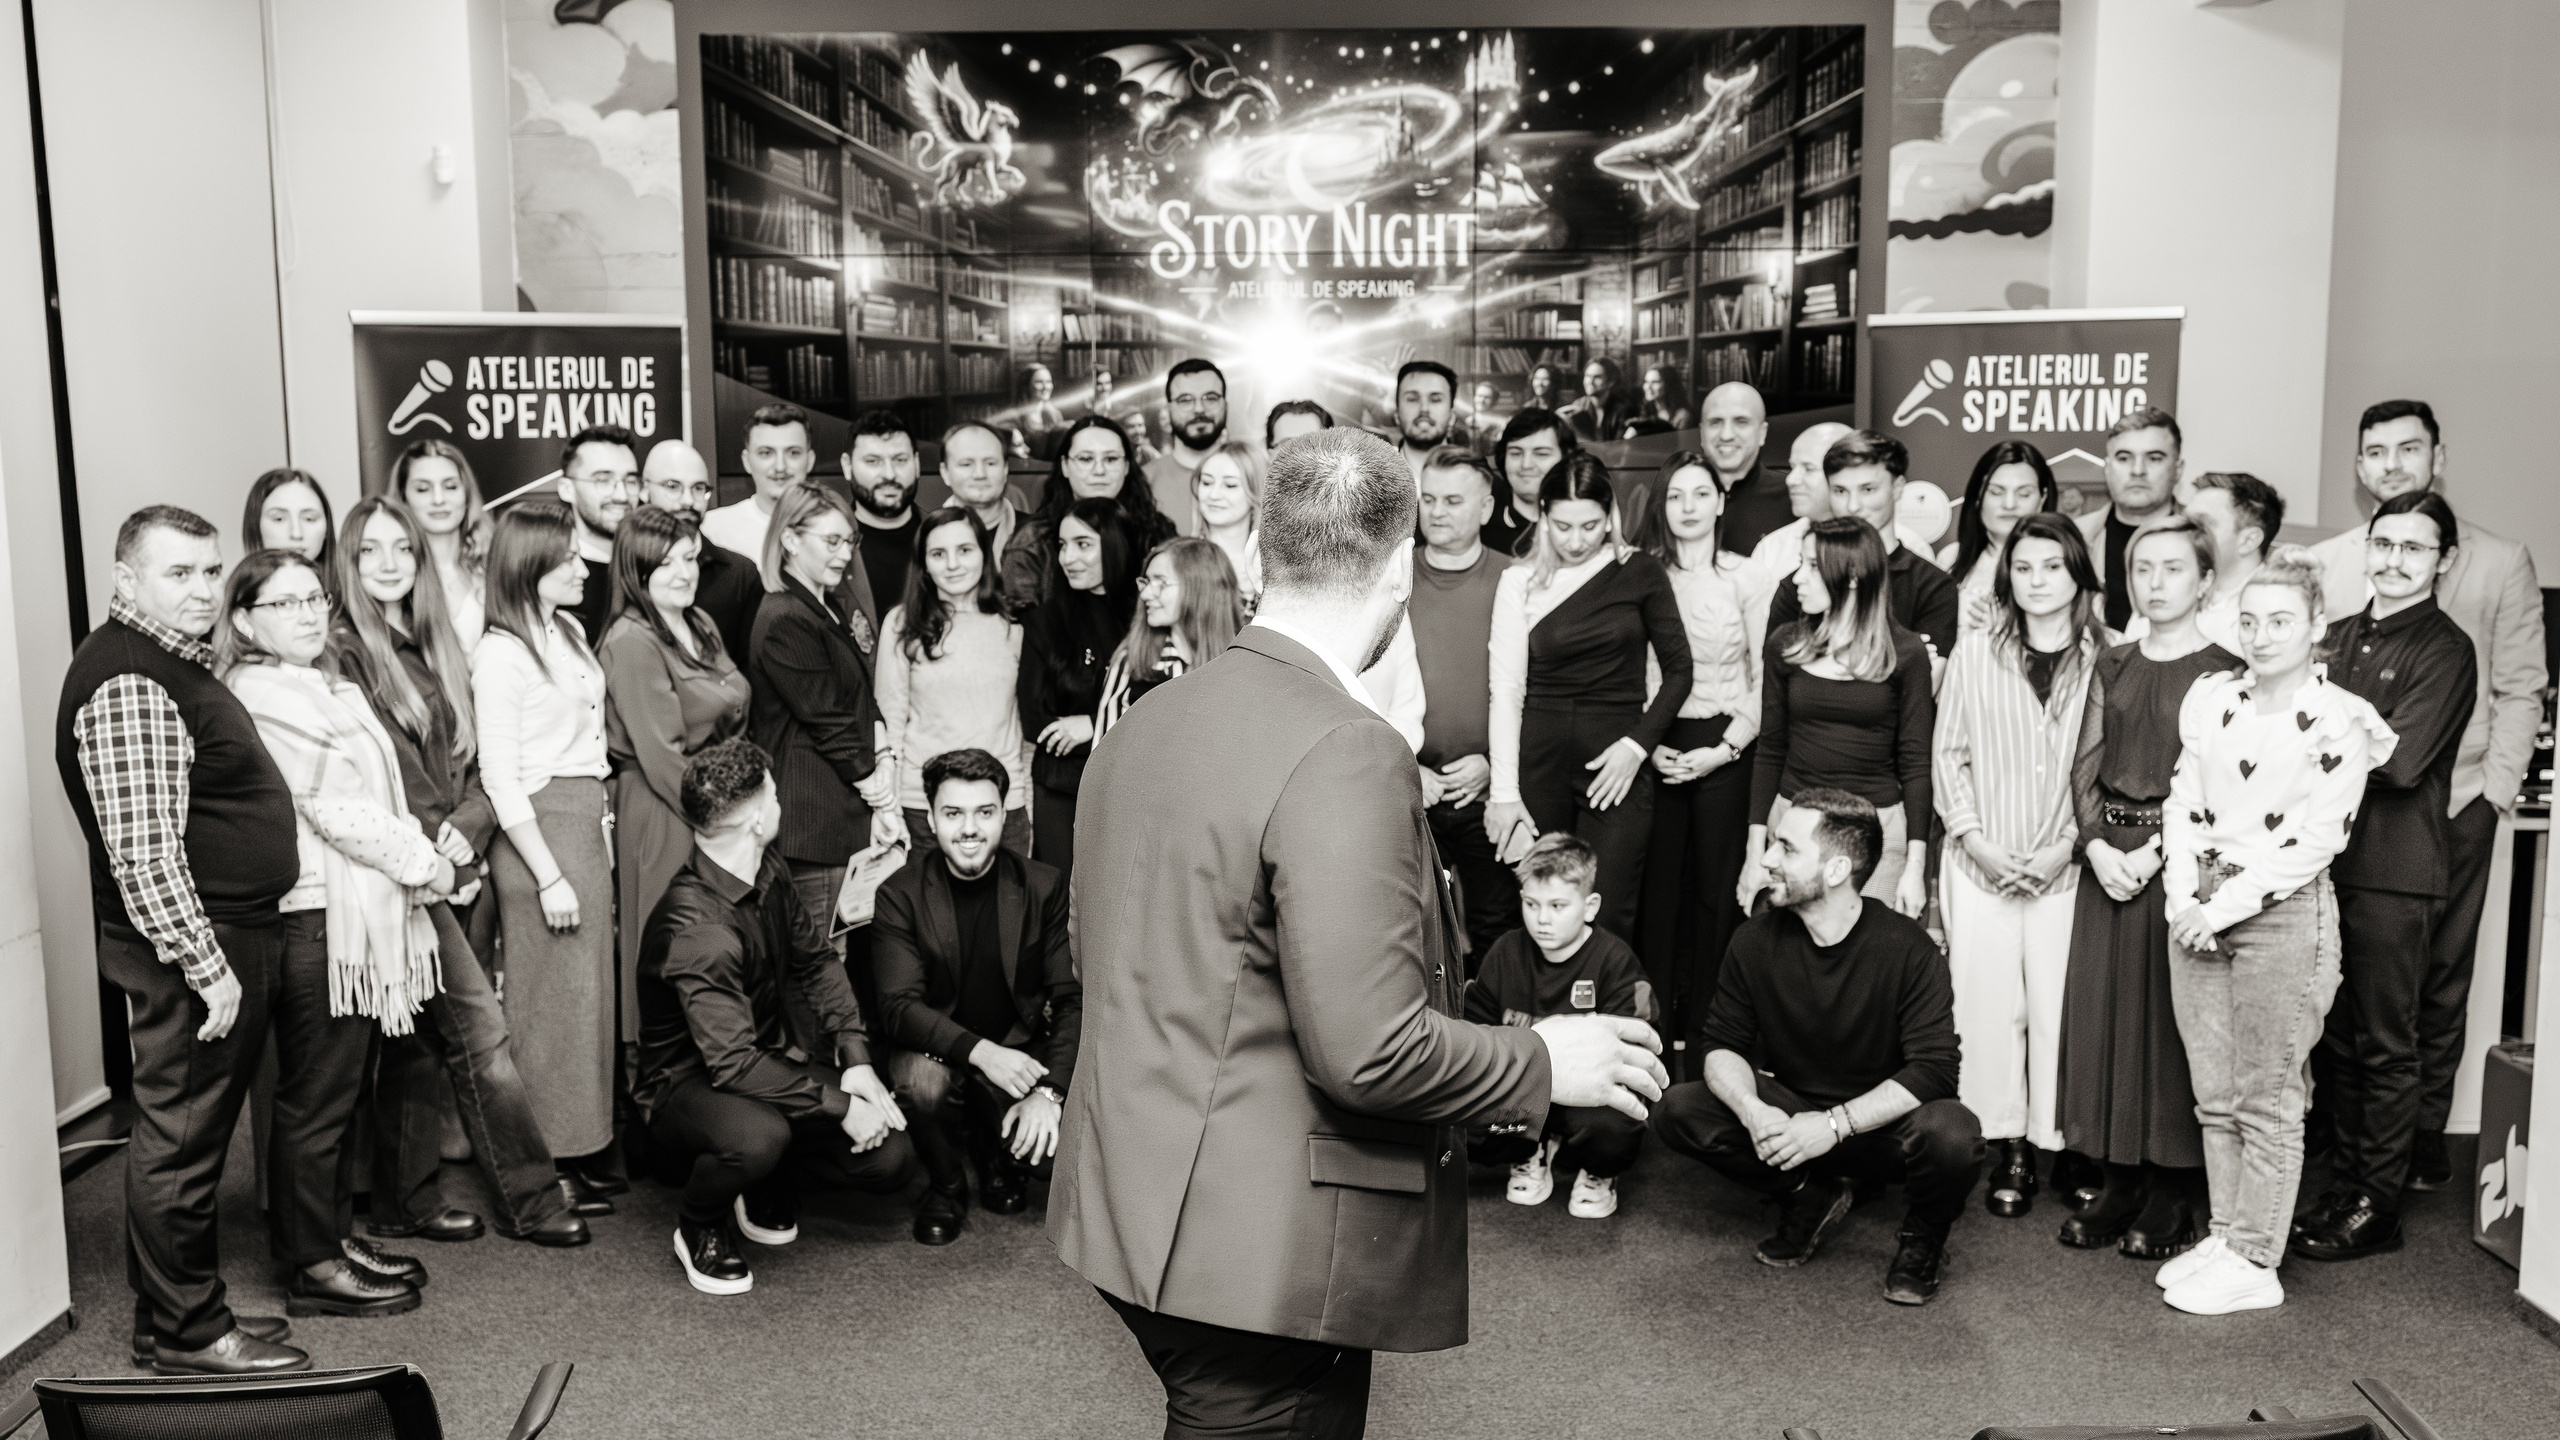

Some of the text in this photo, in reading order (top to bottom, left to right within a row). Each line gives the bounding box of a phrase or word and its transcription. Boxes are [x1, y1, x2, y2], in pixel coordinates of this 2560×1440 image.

[1150, 199, 1479, 279] STORY NIGHT
[1313, 279, 1334, 298] DE
[1337, 279, 1415, 299] SPEAKING
[466, 356, 655, 390] ATELIERUL DE
[1963, 352, 2149, 387] ATELIERUL DE
[466, 392, 656, 440] SPEAKING
[1961, 387, 2147, 433] SPEAKING
